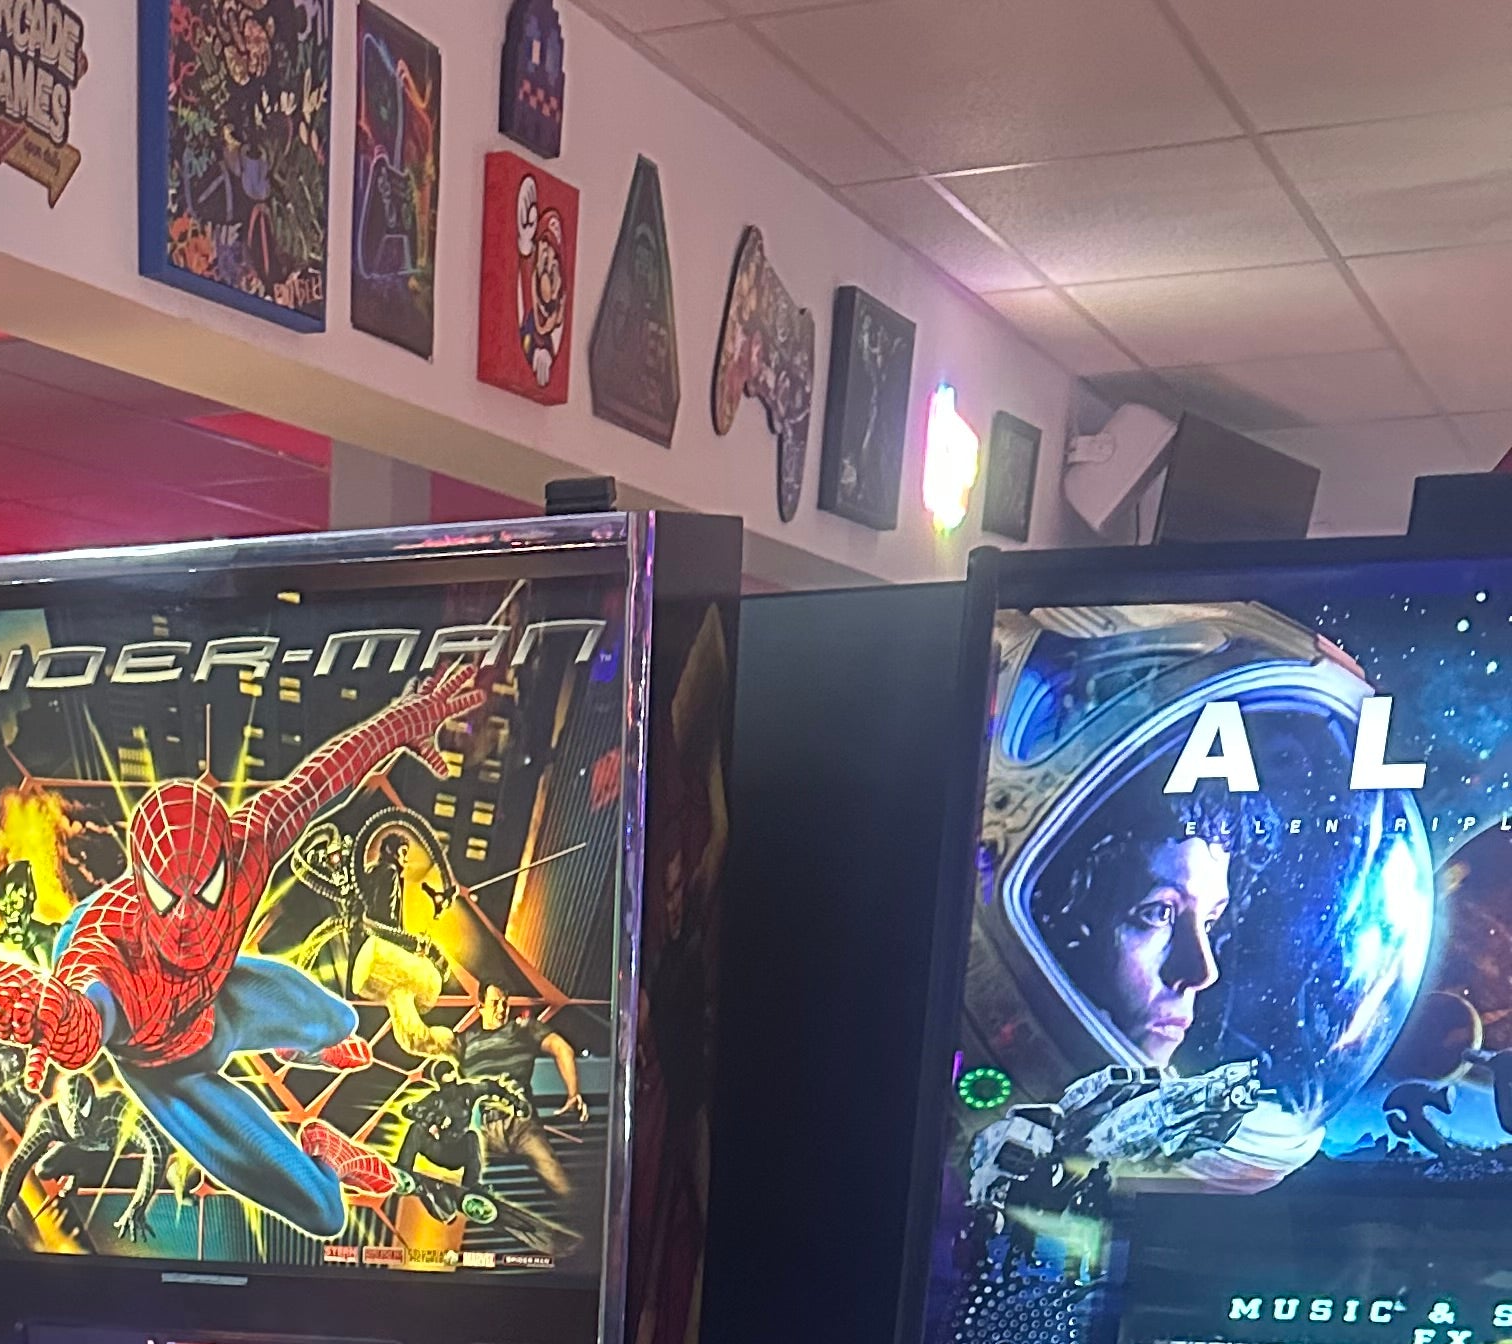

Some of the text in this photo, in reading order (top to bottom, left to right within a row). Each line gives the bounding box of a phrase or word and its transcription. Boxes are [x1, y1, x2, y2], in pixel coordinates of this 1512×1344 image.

[1185, 818, 1340, 837] ELLEN
[1228, 1297, 1394, 1324] MUSIC
[1427, 1302, 1456, 1325] &
